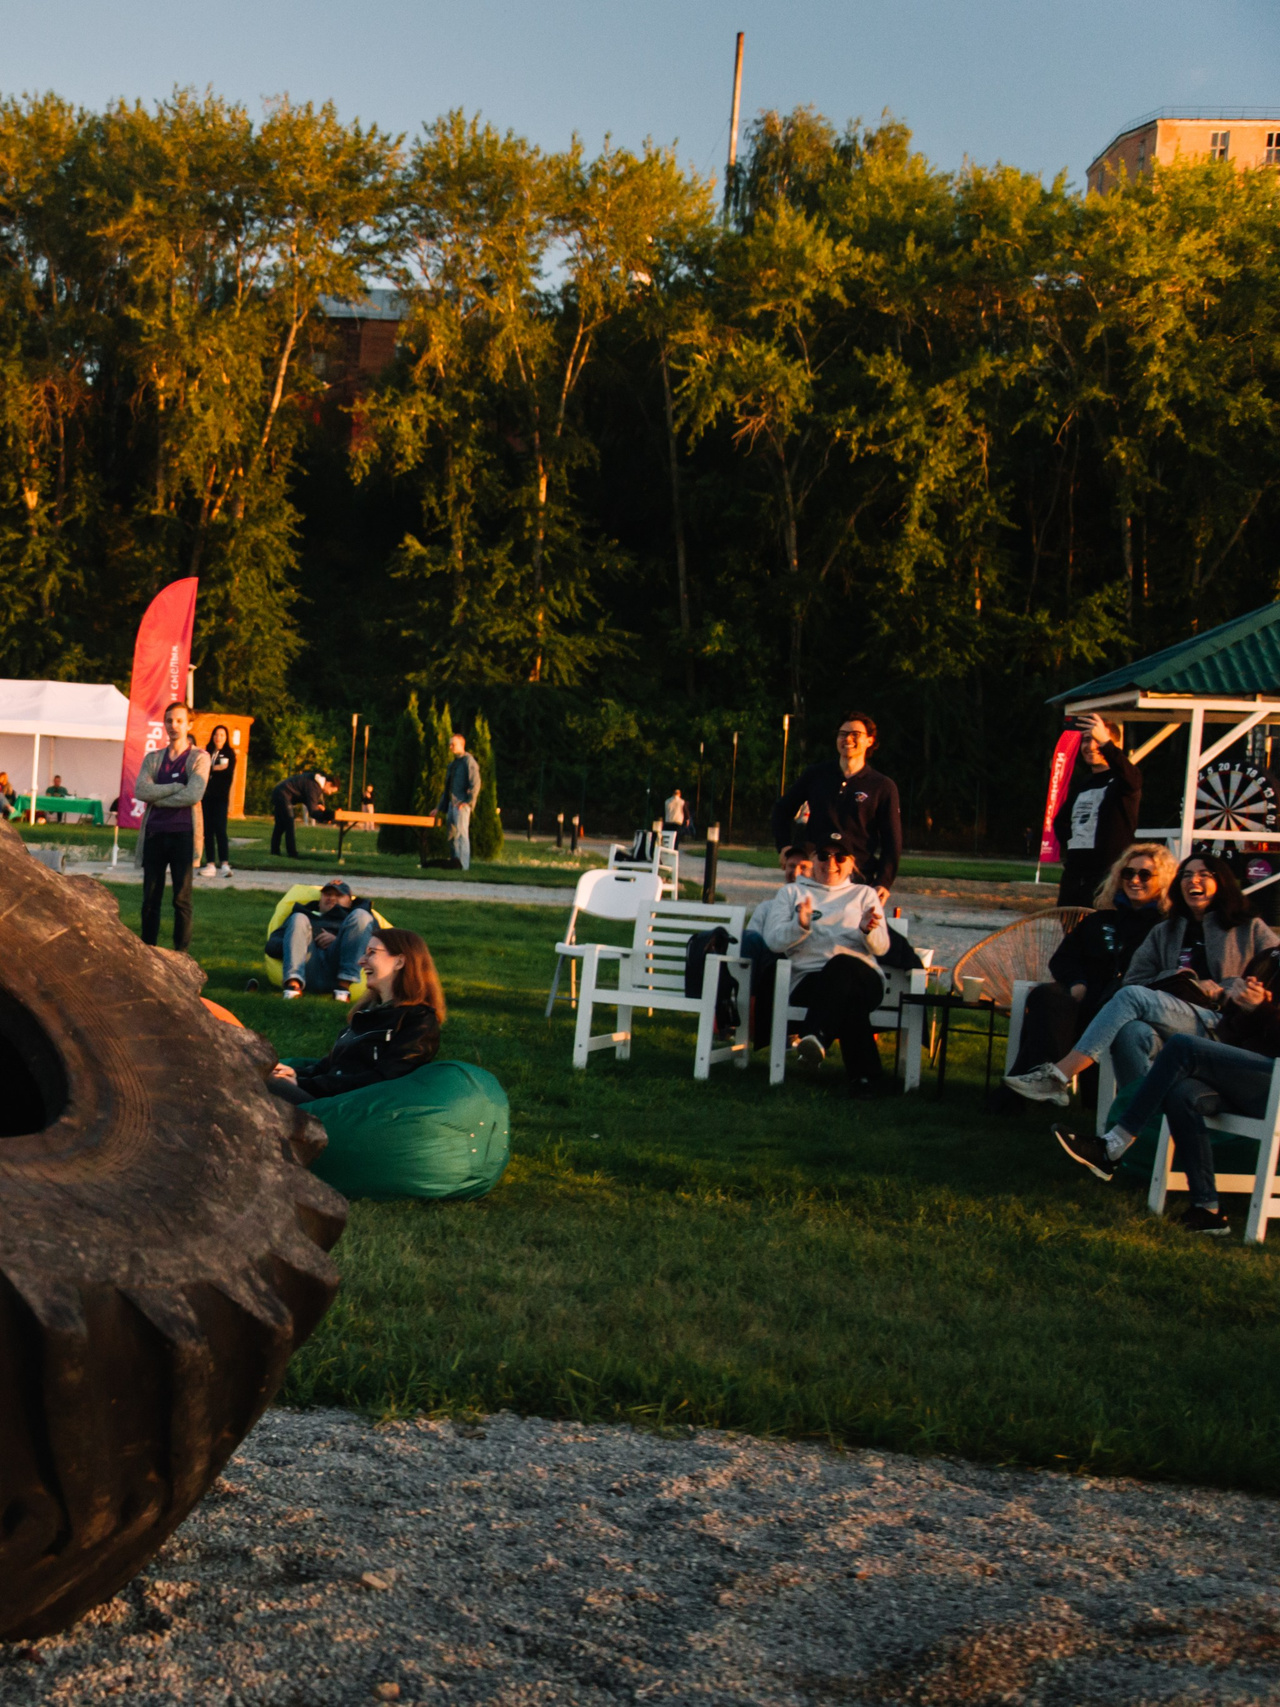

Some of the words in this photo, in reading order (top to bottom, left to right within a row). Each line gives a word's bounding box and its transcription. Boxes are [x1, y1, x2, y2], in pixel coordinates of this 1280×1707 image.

[145, 721, 164, 755] РЫ
[1218, 762, 1230, 770] 20
[1235, 763, 1240, 771] 1
[1246, 767, 1258, 777] 18
[1226, 850, 1232, 858] 3
